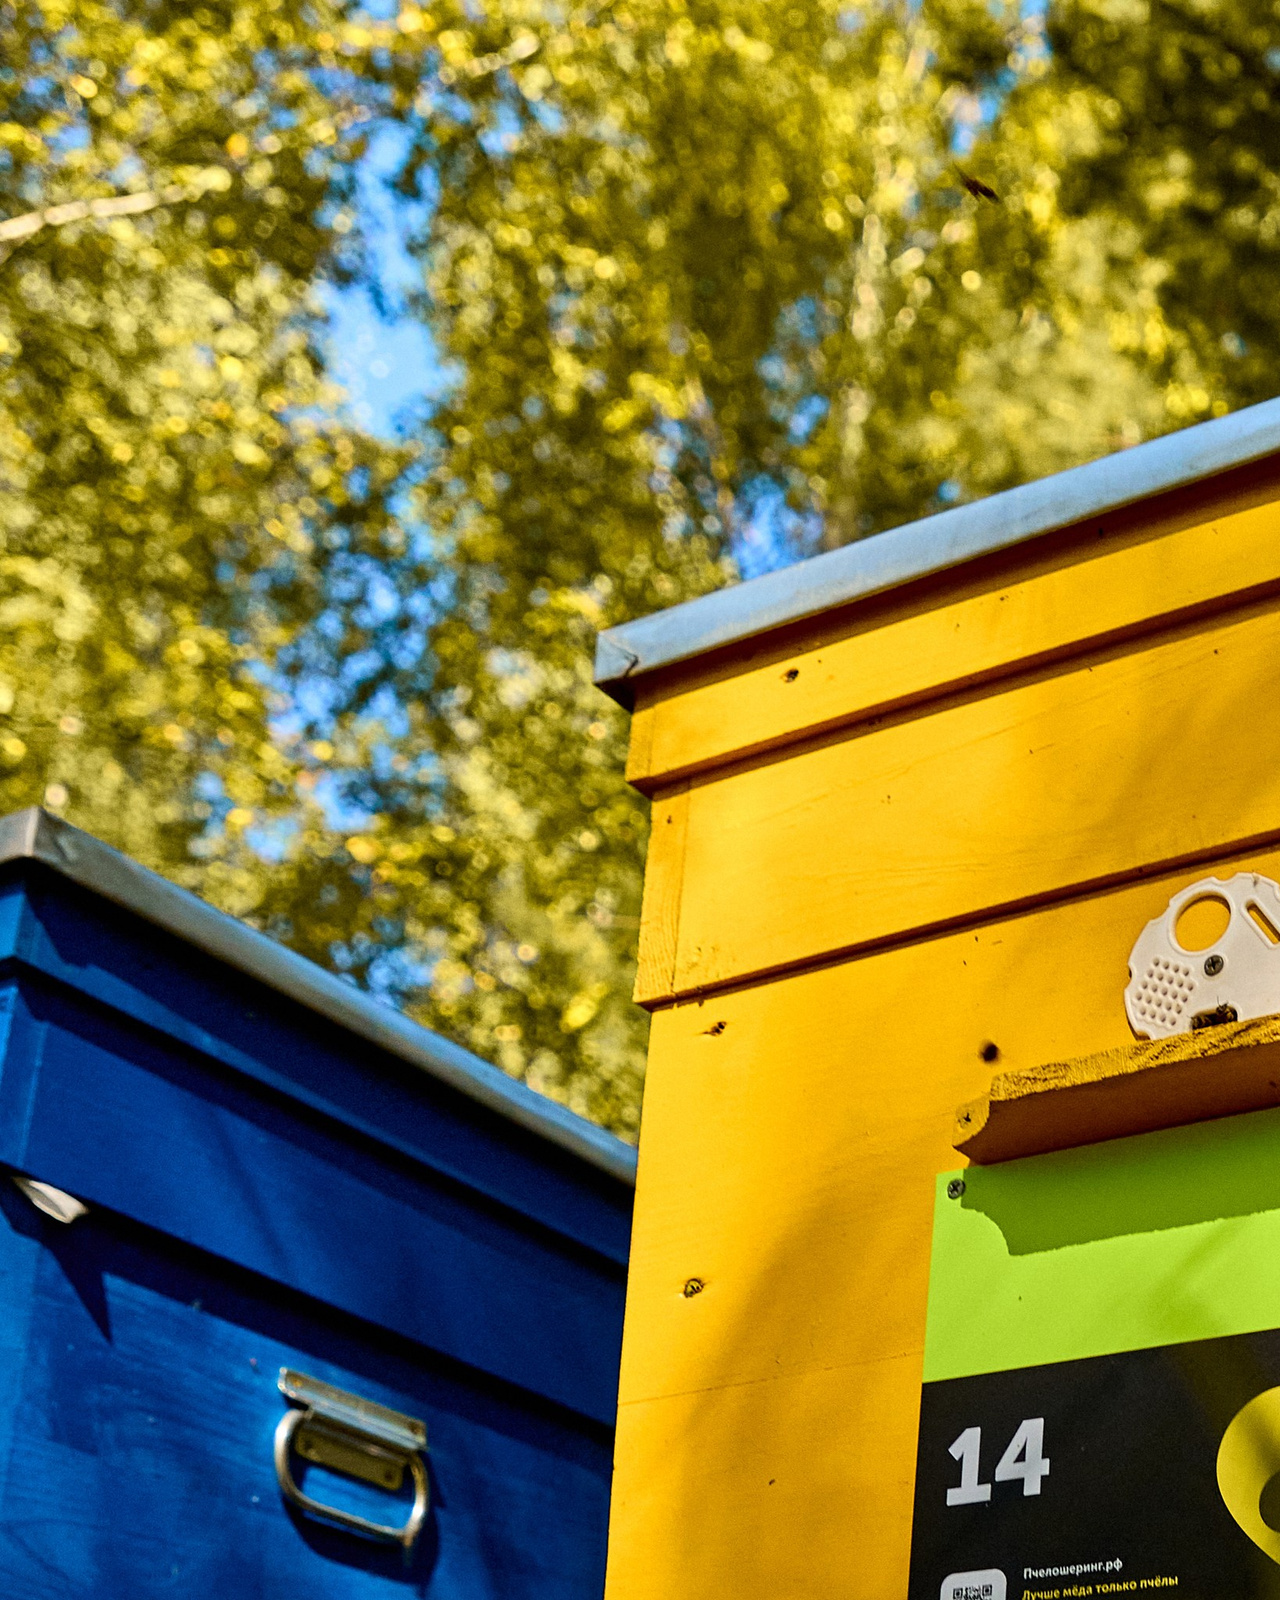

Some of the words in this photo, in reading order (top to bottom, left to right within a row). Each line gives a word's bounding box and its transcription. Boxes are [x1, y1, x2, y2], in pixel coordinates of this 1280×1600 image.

[946, 1417, 1050, 1507] 14
[1023, 1557, 1123, 1580] Пчелошеринг.рф
[1062, 1584, 1093, 1598] мёда
[1095, 1580, 1137, 1594] только
[1139, 1575, 1179, 1589] пчёлы
